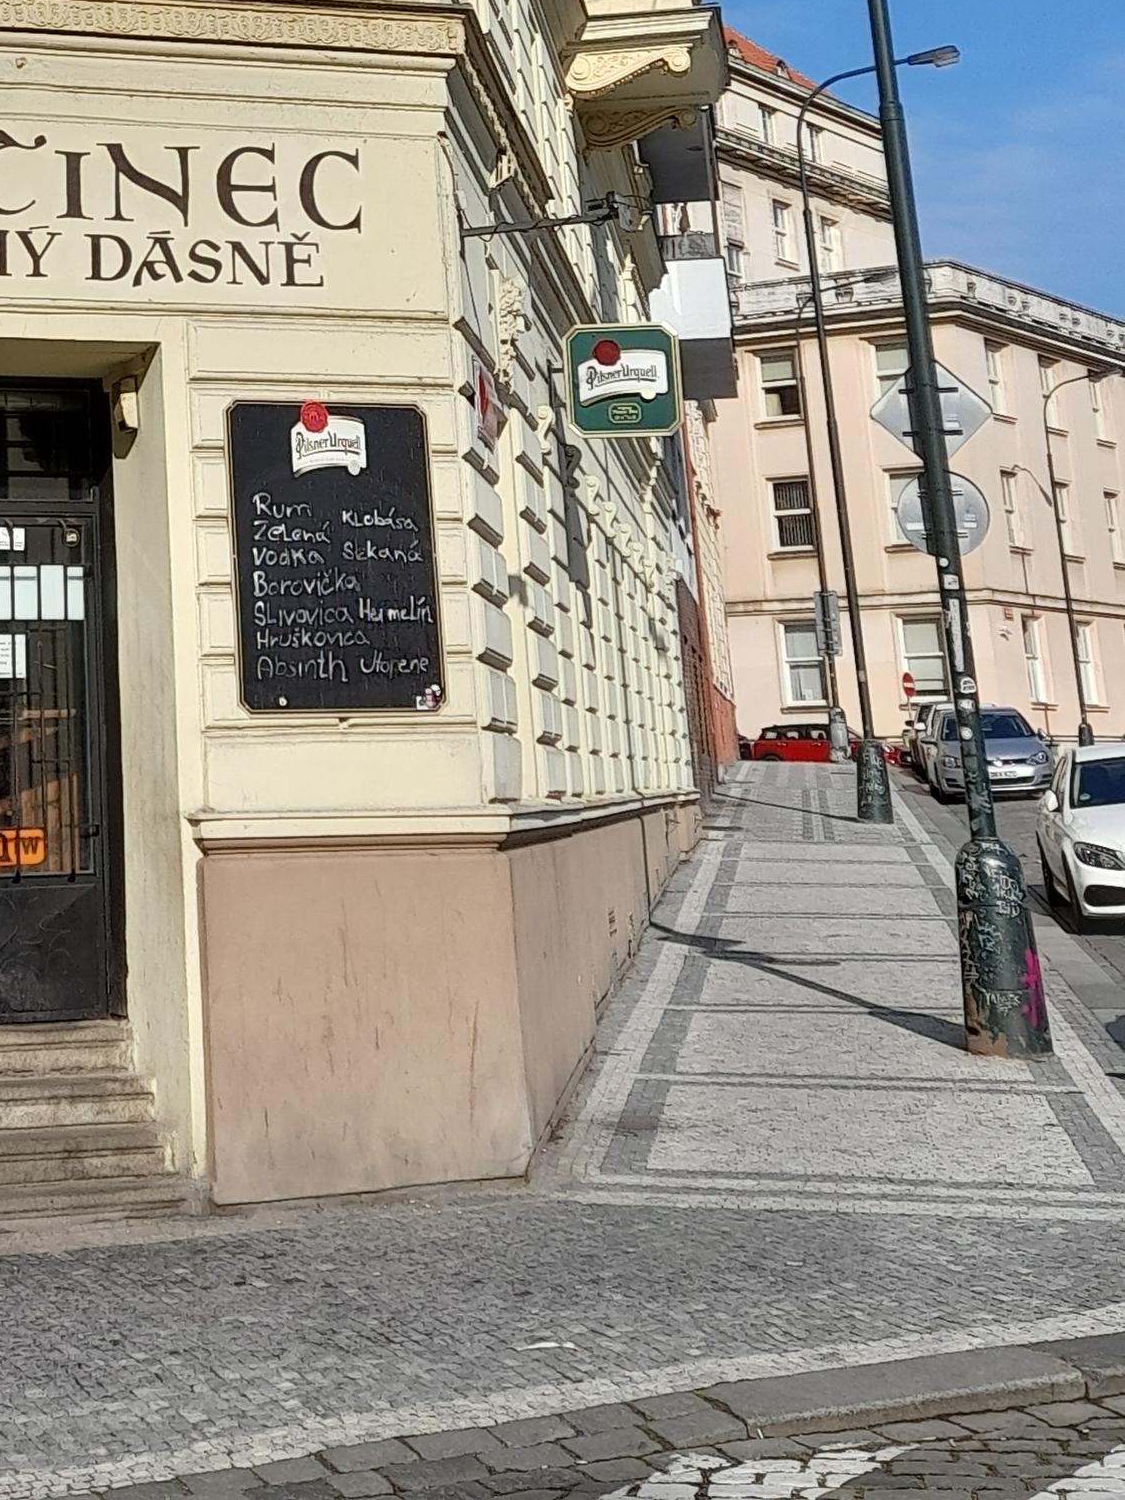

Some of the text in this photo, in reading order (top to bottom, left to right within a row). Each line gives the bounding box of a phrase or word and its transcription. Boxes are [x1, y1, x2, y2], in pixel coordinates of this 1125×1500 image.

[84, 230, 325, 288] DÁSNĚ
[586, 362, 658, 391] Pilsner Urquell
[296, 430, 361, 460] Pilsner Urquell
[252, 492, 312, 518] Rum
[252, 567, 361, 597] Borovička
[257, 650, 349, 682] Absinth
